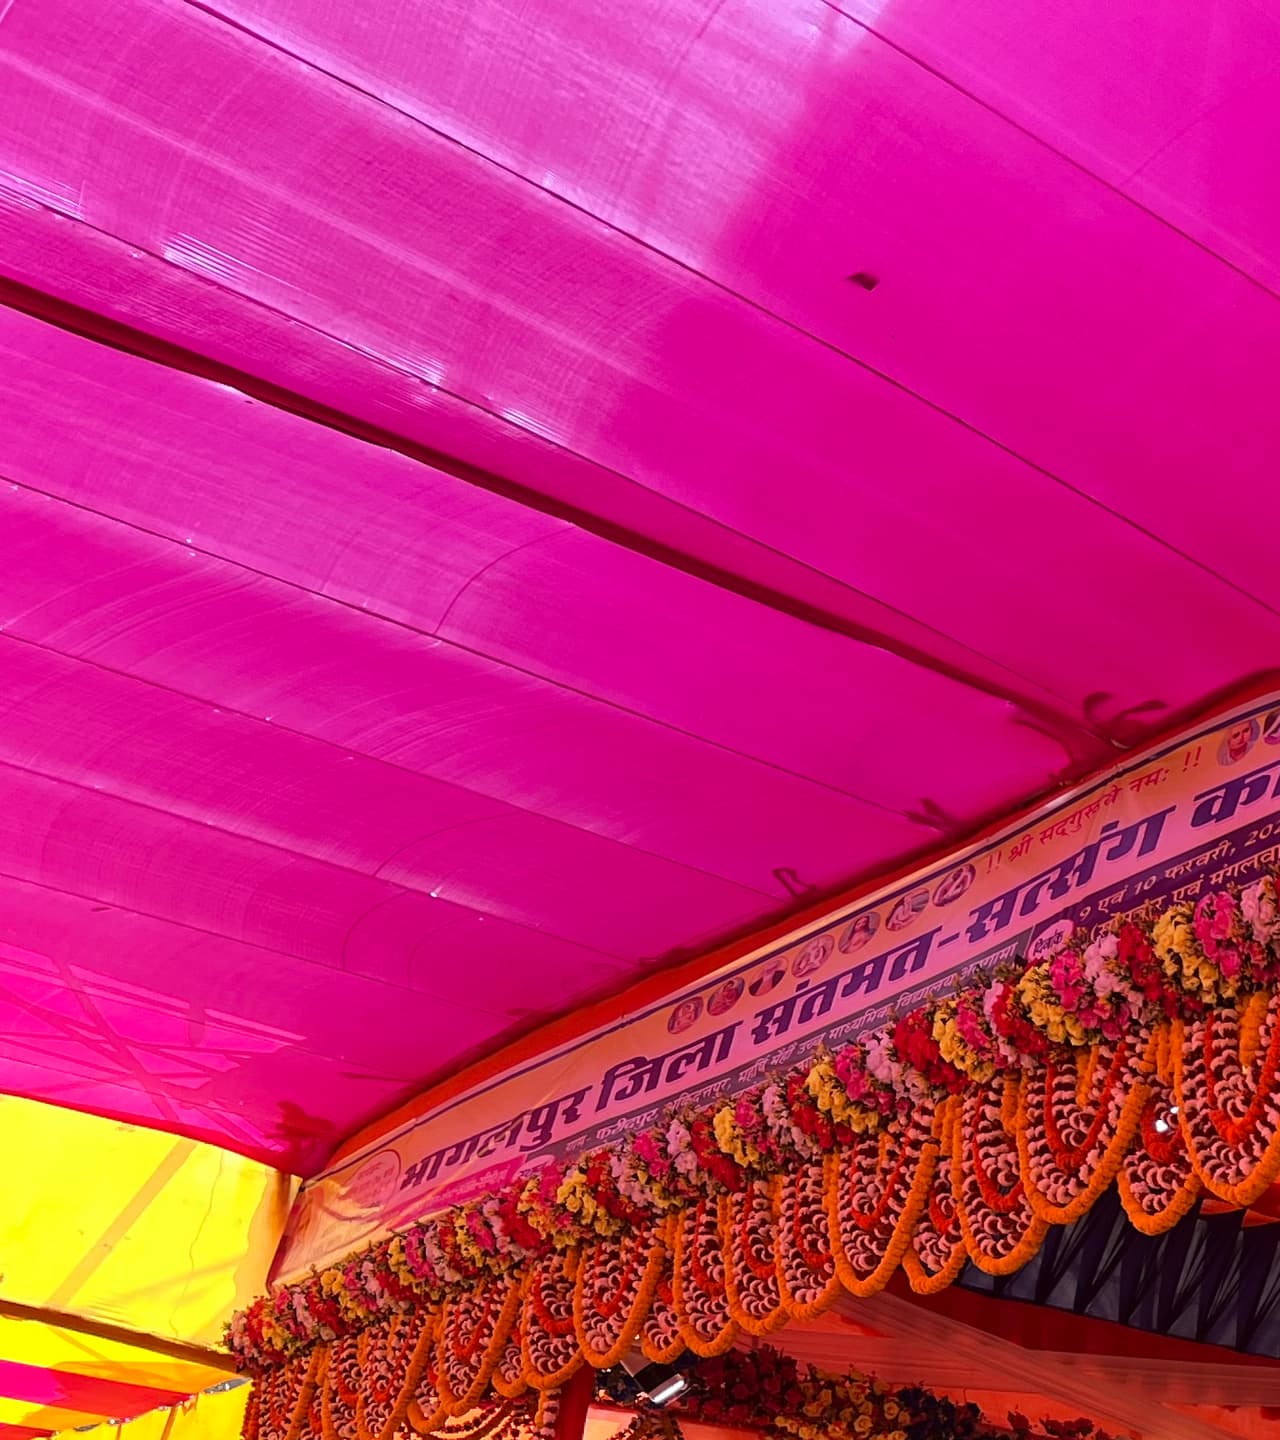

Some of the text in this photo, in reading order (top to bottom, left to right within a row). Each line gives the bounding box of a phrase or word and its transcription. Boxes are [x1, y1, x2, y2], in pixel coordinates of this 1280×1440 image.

[1008, 834, 1034, 862] श्री
[1098, 884, 1128, 913] एवं
[1134, 875, 1157, 896] 10
[1164, 839, 1237, 880] फरवरी,
[1171, 873, 1204, 904] एवं
[401, 1085, 593, 1190] भागलपुर
[595, 1021, 743, 1112] जिला
[751, 805, 1177, 1046] संतमत-सत्संग
